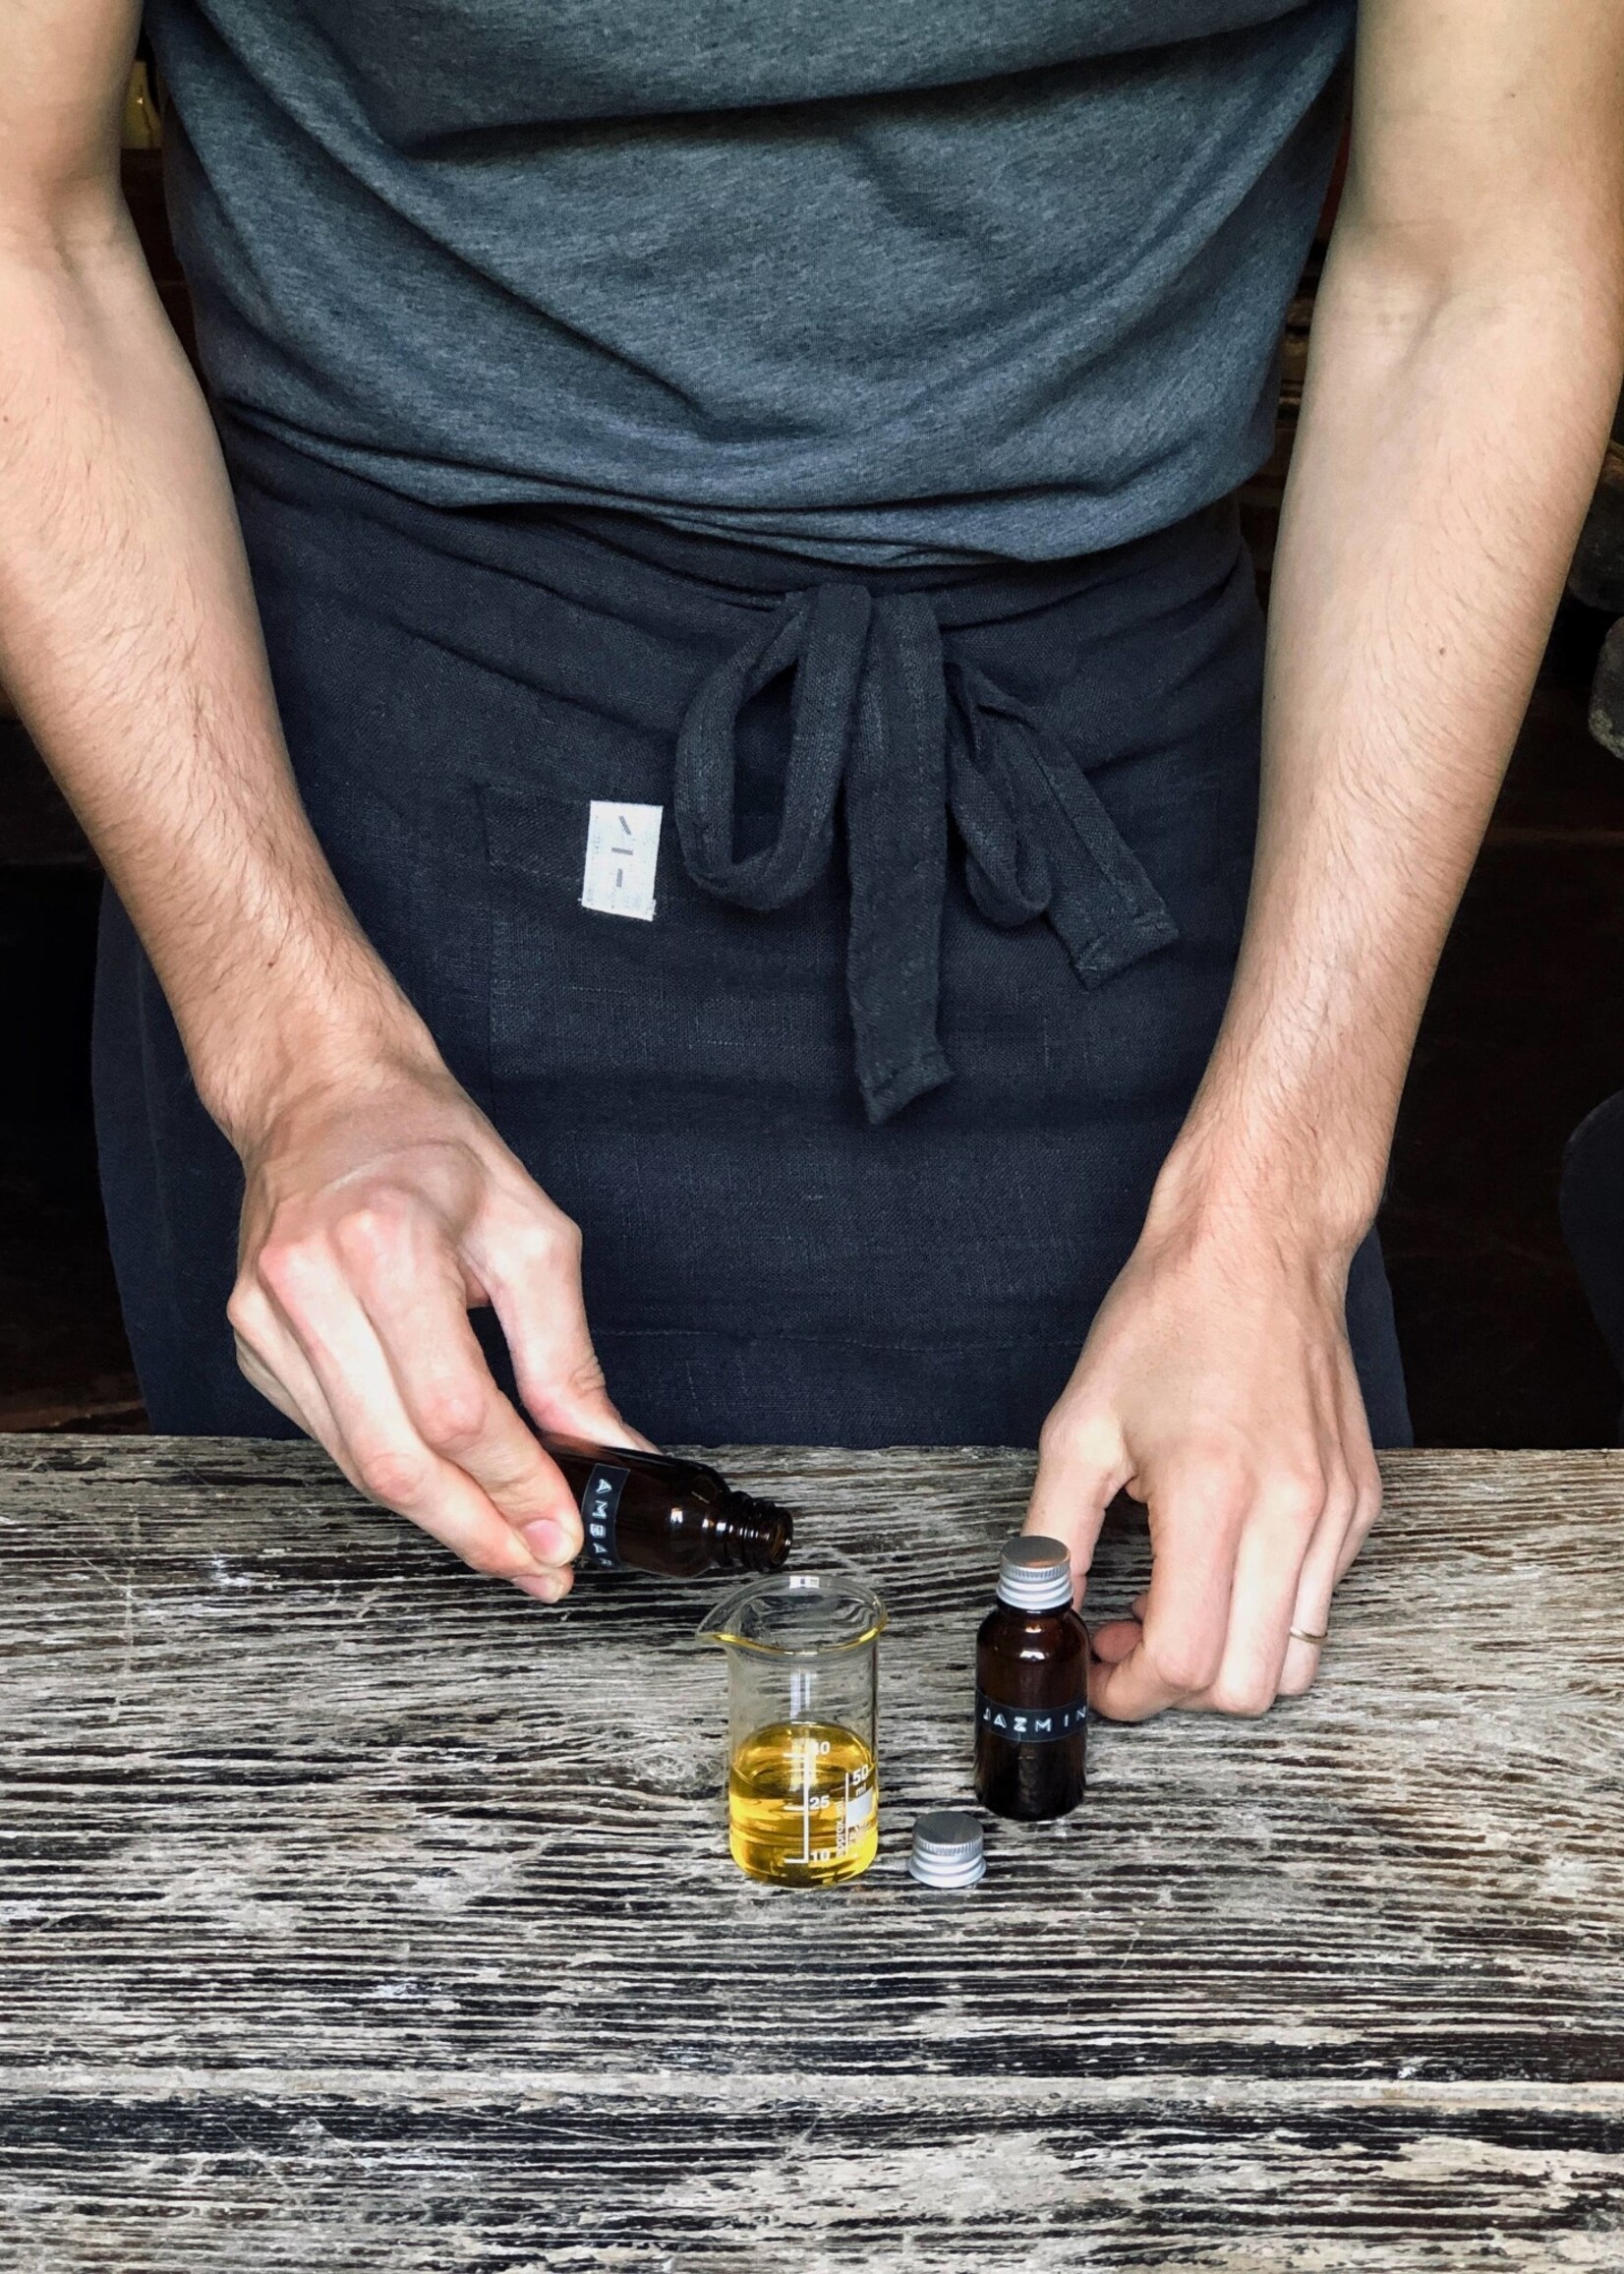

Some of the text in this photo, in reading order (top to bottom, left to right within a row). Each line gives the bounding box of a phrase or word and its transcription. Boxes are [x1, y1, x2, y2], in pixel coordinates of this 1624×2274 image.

[983, 1707, 1086, 1732] JAZMIN
[852, 1765, 870, 1784] 50
[810, 1795, 830, 1809] 25
[810, 1849, 830, 1863] 10
